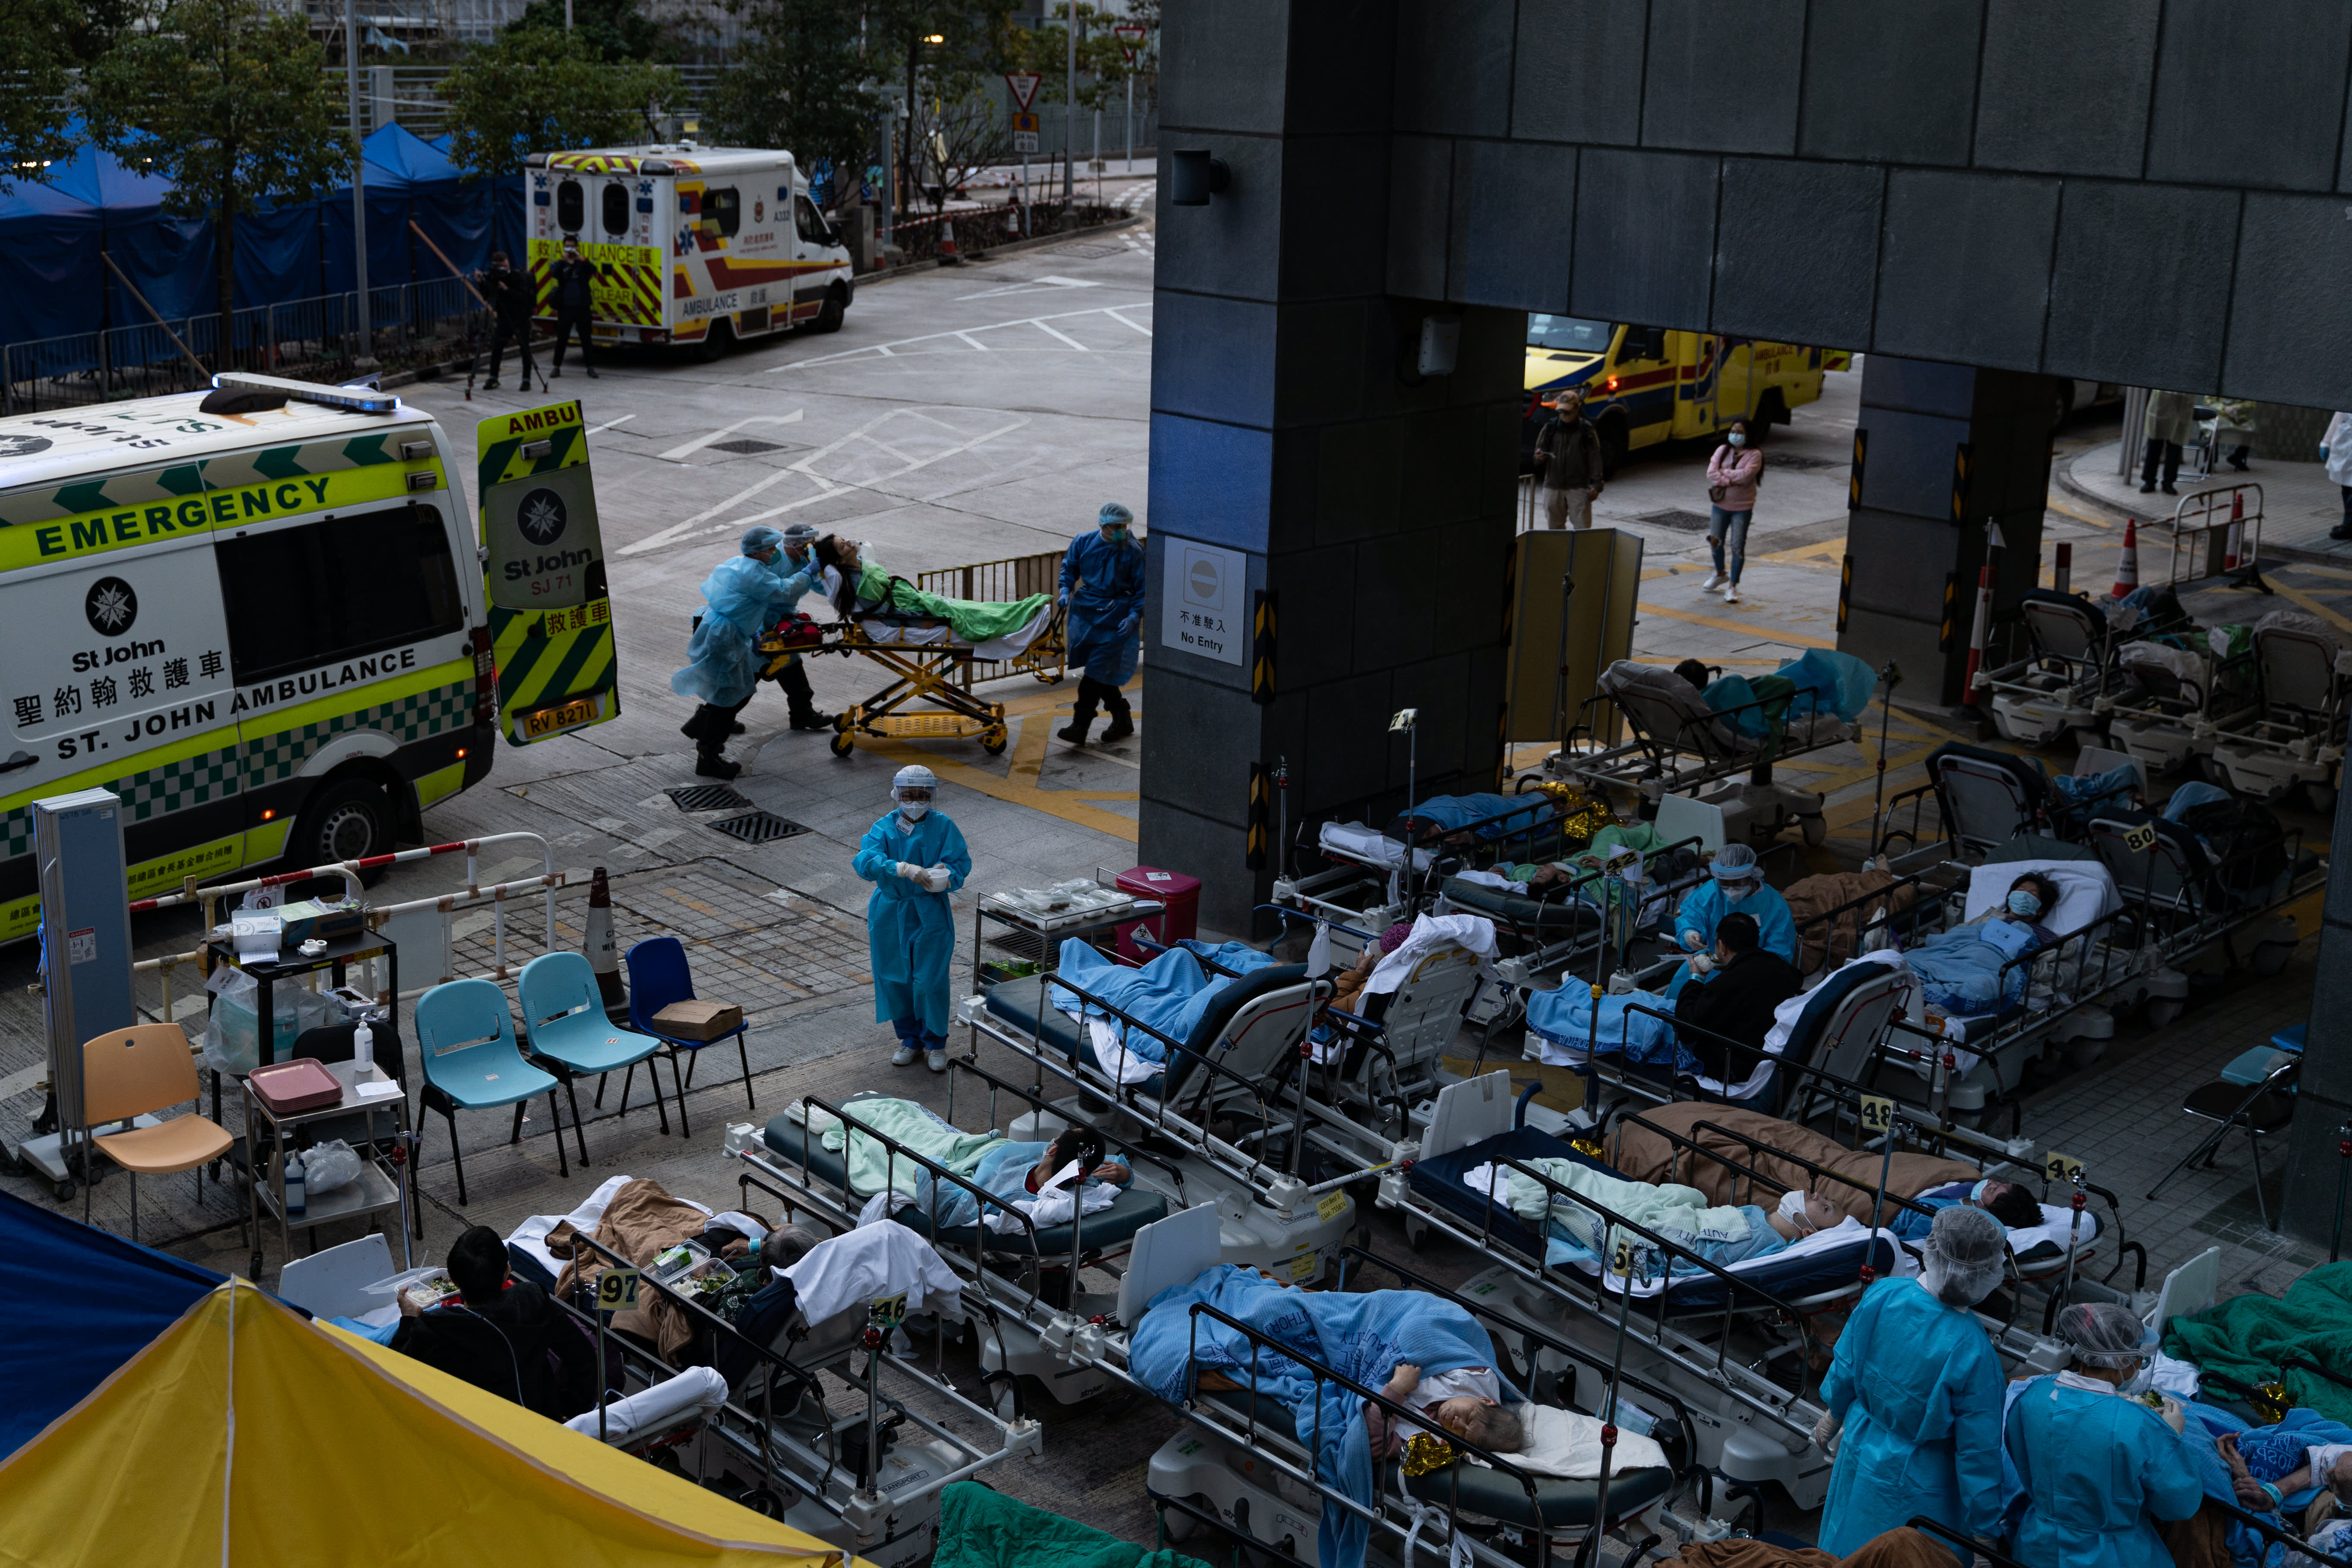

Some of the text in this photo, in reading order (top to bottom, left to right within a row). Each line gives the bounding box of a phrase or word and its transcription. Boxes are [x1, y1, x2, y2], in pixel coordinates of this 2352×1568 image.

[555, 244, 633, 263] AULANCE
[592, 288, 630, 301] CLEAR
[683, 294, 738, 316] AMBULANCE
[35, 477, 329, 556] EMERGENCY
[504, 547, 592, 582] St John
[531, 574, 573, 596] SJ 71
[547, 602, 608, 636] 救護車
[1180, 610, 1226, 634] 不准駛入
[1181, 631, 1223, 653] No Entry
[72, 639, 165, 672] St John
[13, 649, 225, 728] 聖約翰救護車
[57, 649, 415, 759] ST. JOHN AMBULANCE
[529, 703, 592, 735] RV 8271
[345, 751, 363, 759] 450kPa
[896, 824, 909, 834] NURSE
[2127, 828, 2153, 849] 80
[1606, 851, 1637, 871] 42
[70, 929, 94, 938] WARNING
[1863, 1102, 1891, 1127] 48
[1305, 1140, 1328, 1154] stryker
[1320, 1201, 1329, 1209] CEU
[1321, 1201, 1346, 1221] EAM: 755874
[1286, 1212, 1316, 1223] TRANSPOR
[601, 1274, 638, 1302] 97
[1294, 1275, 1315, 1286] stryker
[874, 1296, 906, 1326] 46
[1080, 1384, 1104, 1398] stryker
[882, 1473, 921, 1493] RANSPORT
[890, 1552, 918, 1568] stryker
